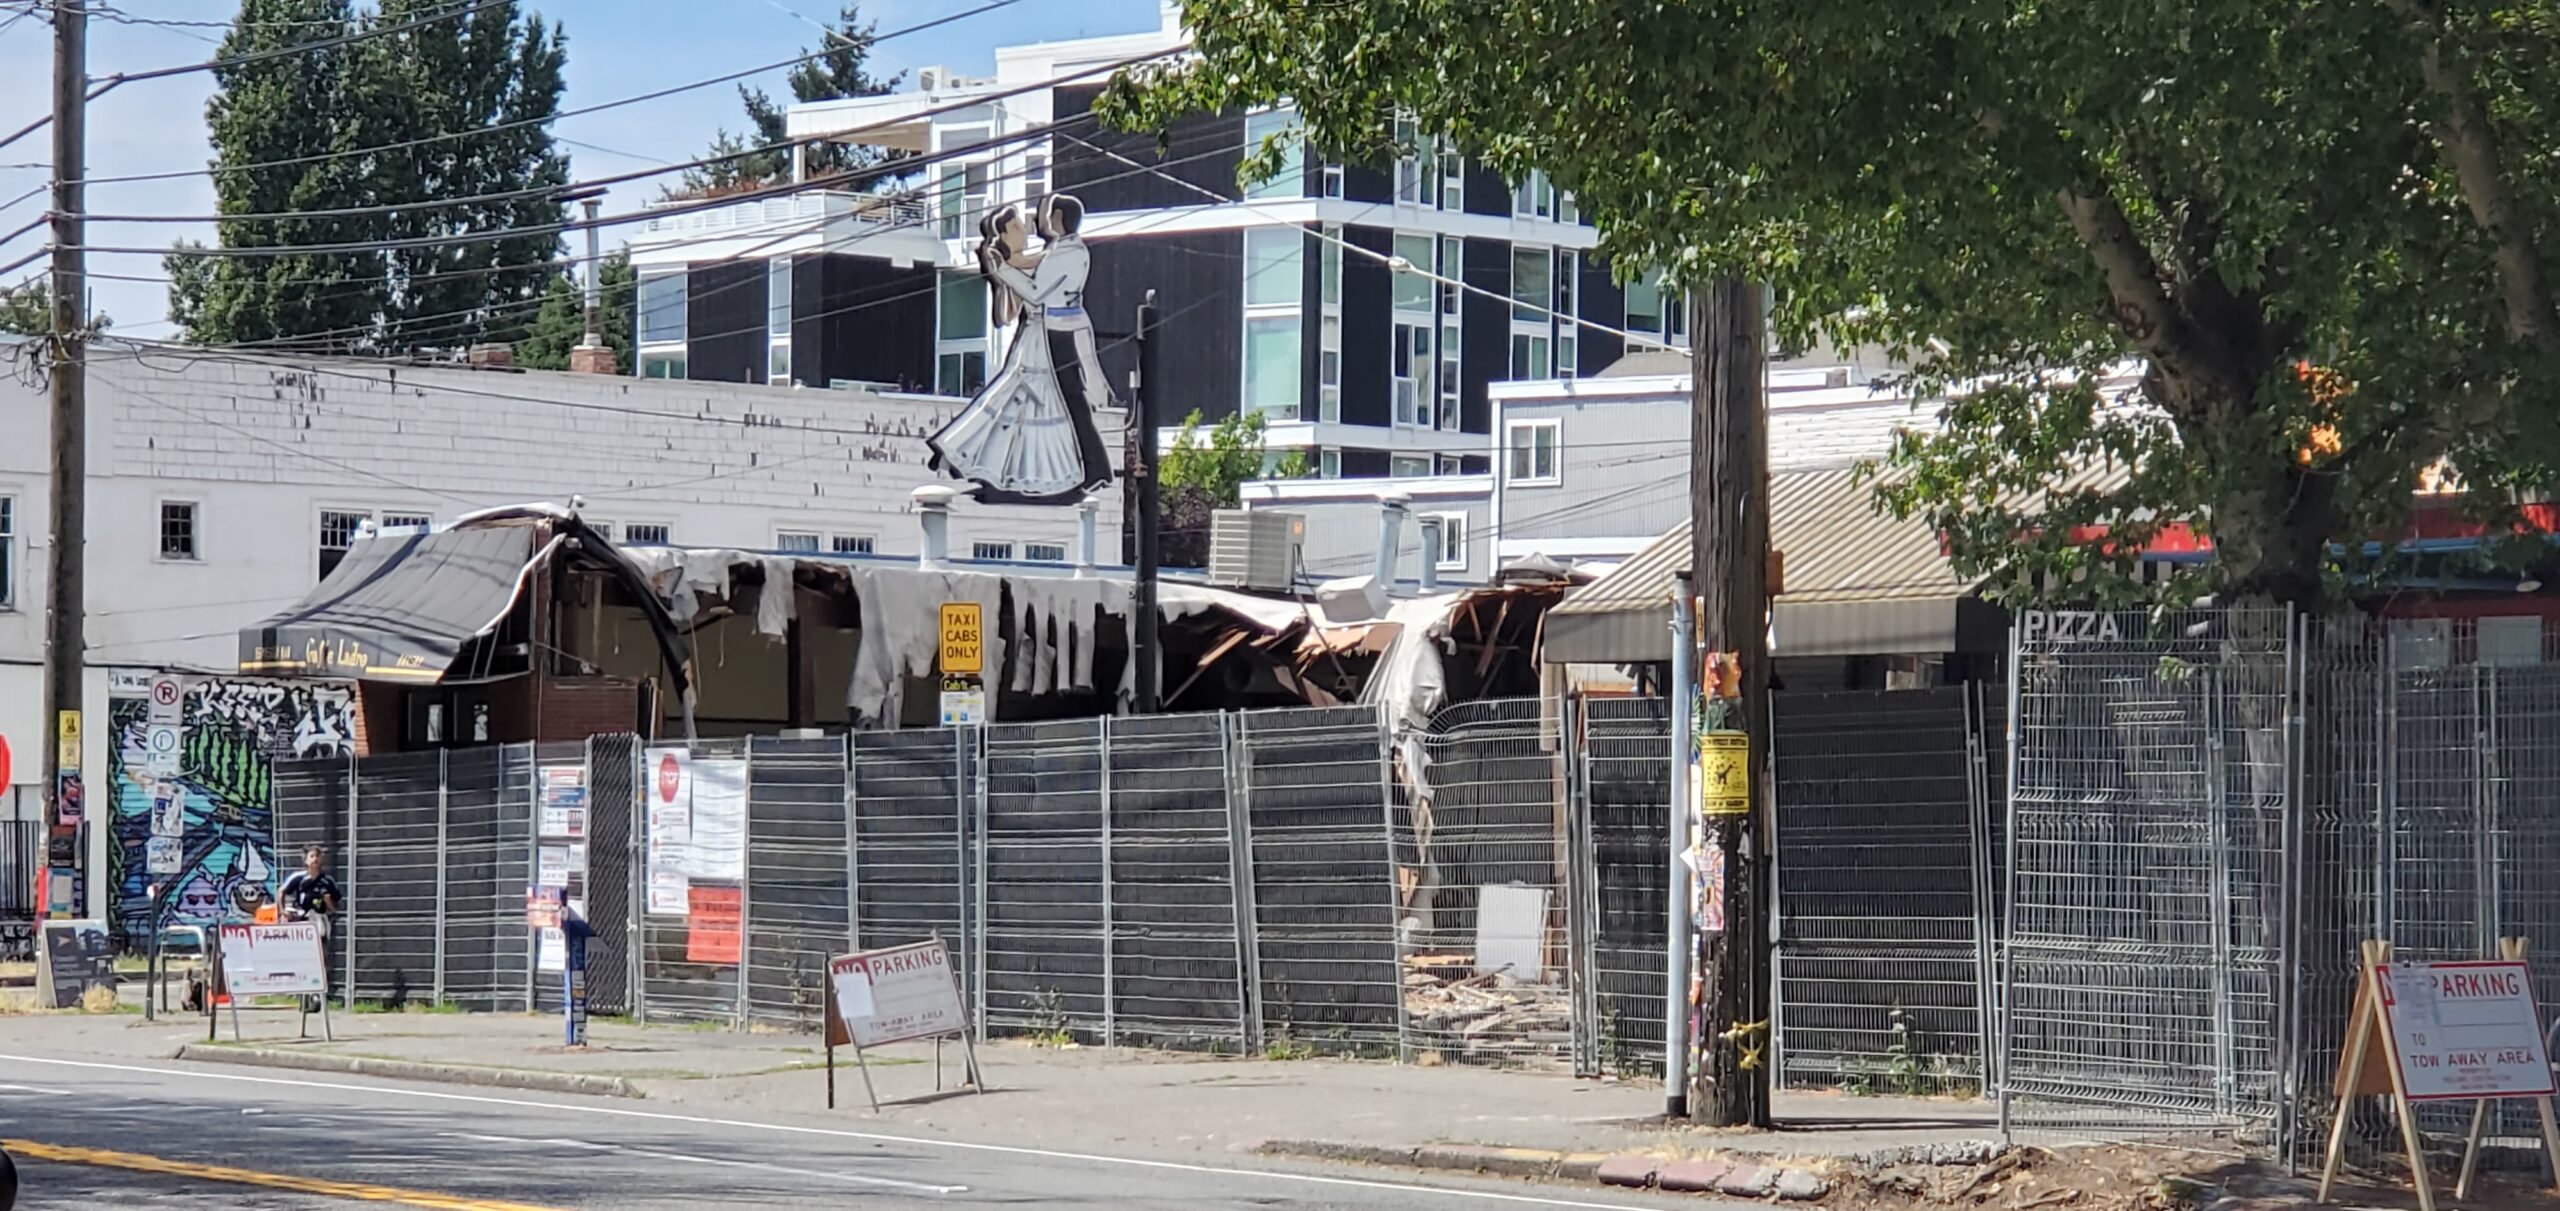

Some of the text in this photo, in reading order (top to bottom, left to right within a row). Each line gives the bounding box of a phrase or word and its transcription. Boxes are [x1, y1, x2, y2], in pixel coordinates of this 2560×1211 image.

[947, 614, 976, 626] TAXI
[2024, 609, 2118, 642] PIZZA
[946, 630, 978, 642] CABS
[946, 646, 979, 659] ONLY
[255, 928, 314, 943] PARKING
[872, 949, 943, 977] PARKING
[2410, 1032, 2426, 1046] TO
[2410, 1051, 2537, 1068] TOW AWAY AREA
